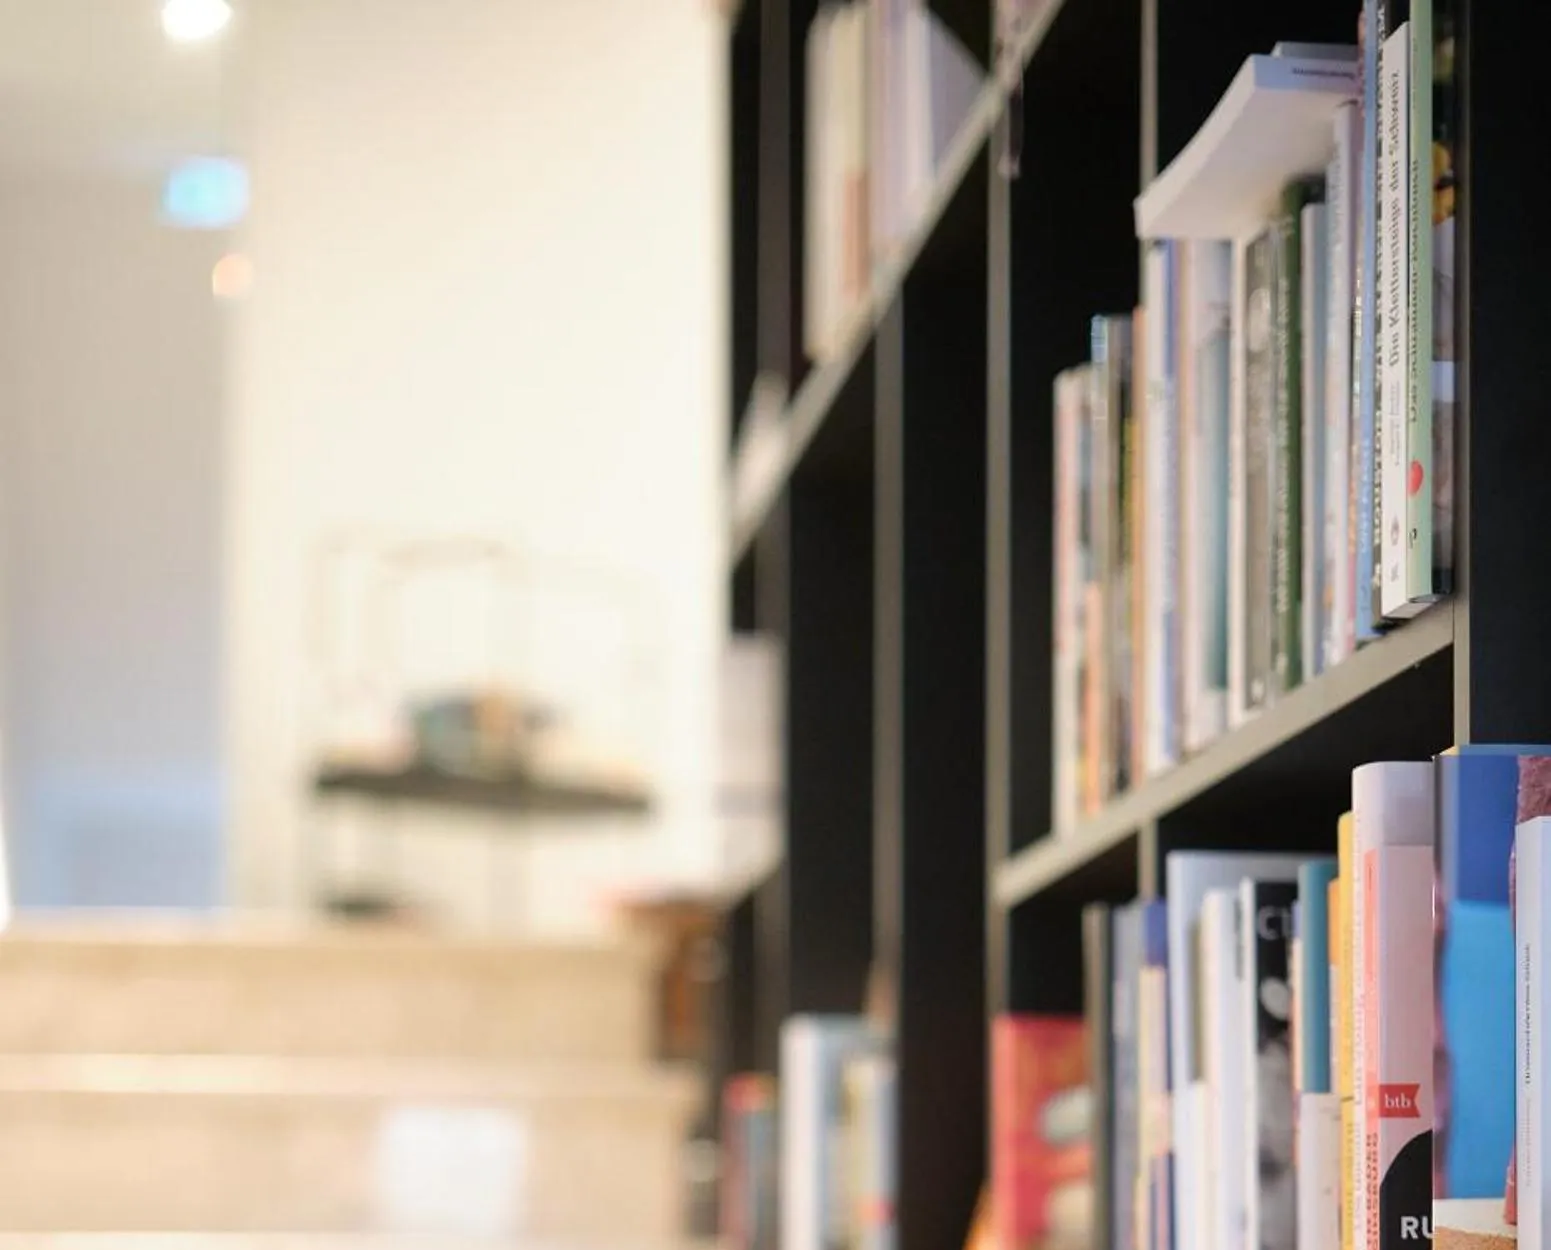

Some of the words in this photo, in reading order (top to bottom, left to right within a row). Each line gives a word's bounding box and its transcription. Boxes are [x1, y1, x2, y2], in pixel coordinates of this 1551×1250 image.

[1388, 71, 1400, 156] Schweiz
[1388, 160, 1400, 192] der
[1388, 197, 1402, 328] Klettersteige
[1388, 331, 1400, 366] Die
[1384, 1094, 1411, 1109] btb
